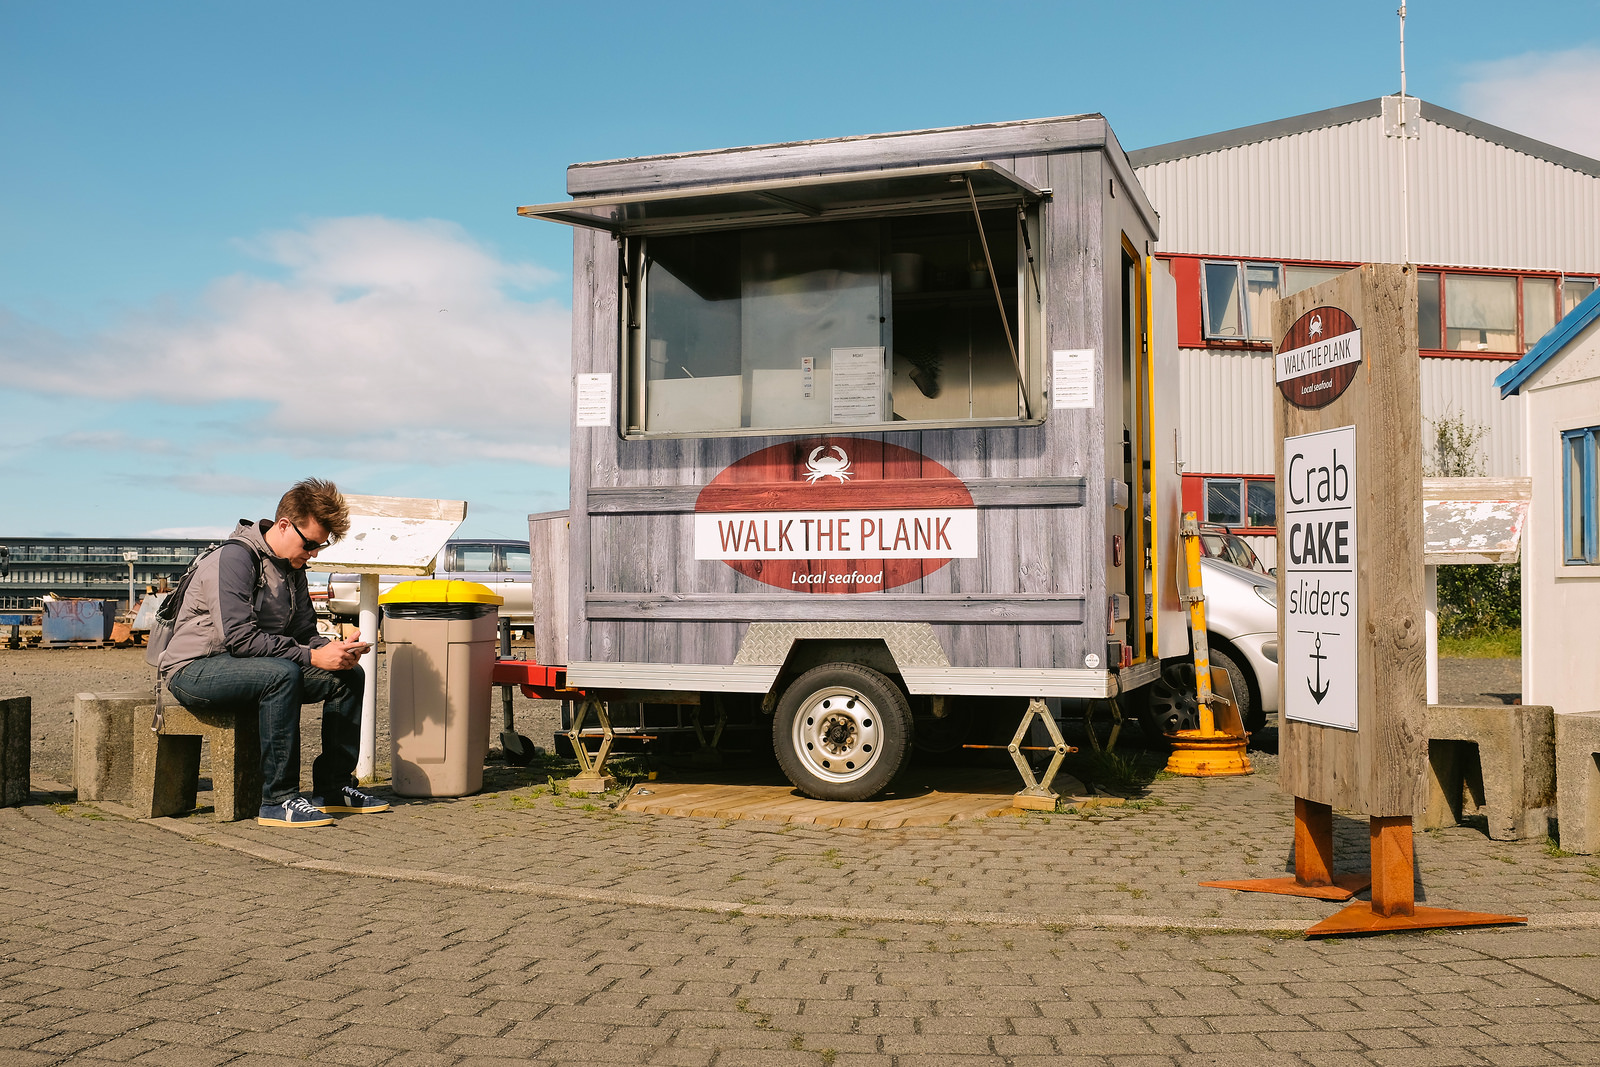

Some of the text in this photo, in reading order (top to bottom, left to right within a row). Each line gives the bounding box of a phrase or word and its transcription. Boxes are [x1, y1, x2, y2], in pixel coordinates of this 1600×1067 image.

[1284, 338, 1351, 375] WALK THE PLANK
[1301, 378, 1333, 395] Local seafood
[1288, 448, 1349, 505] Crab
[717, 516, 952, 552] WALK THE PLANK
[1289, 521, 1349, 564] CAKE
[791, 570, 883, 584] Local seafood
[1289, 579, 1350, 617] sliders
